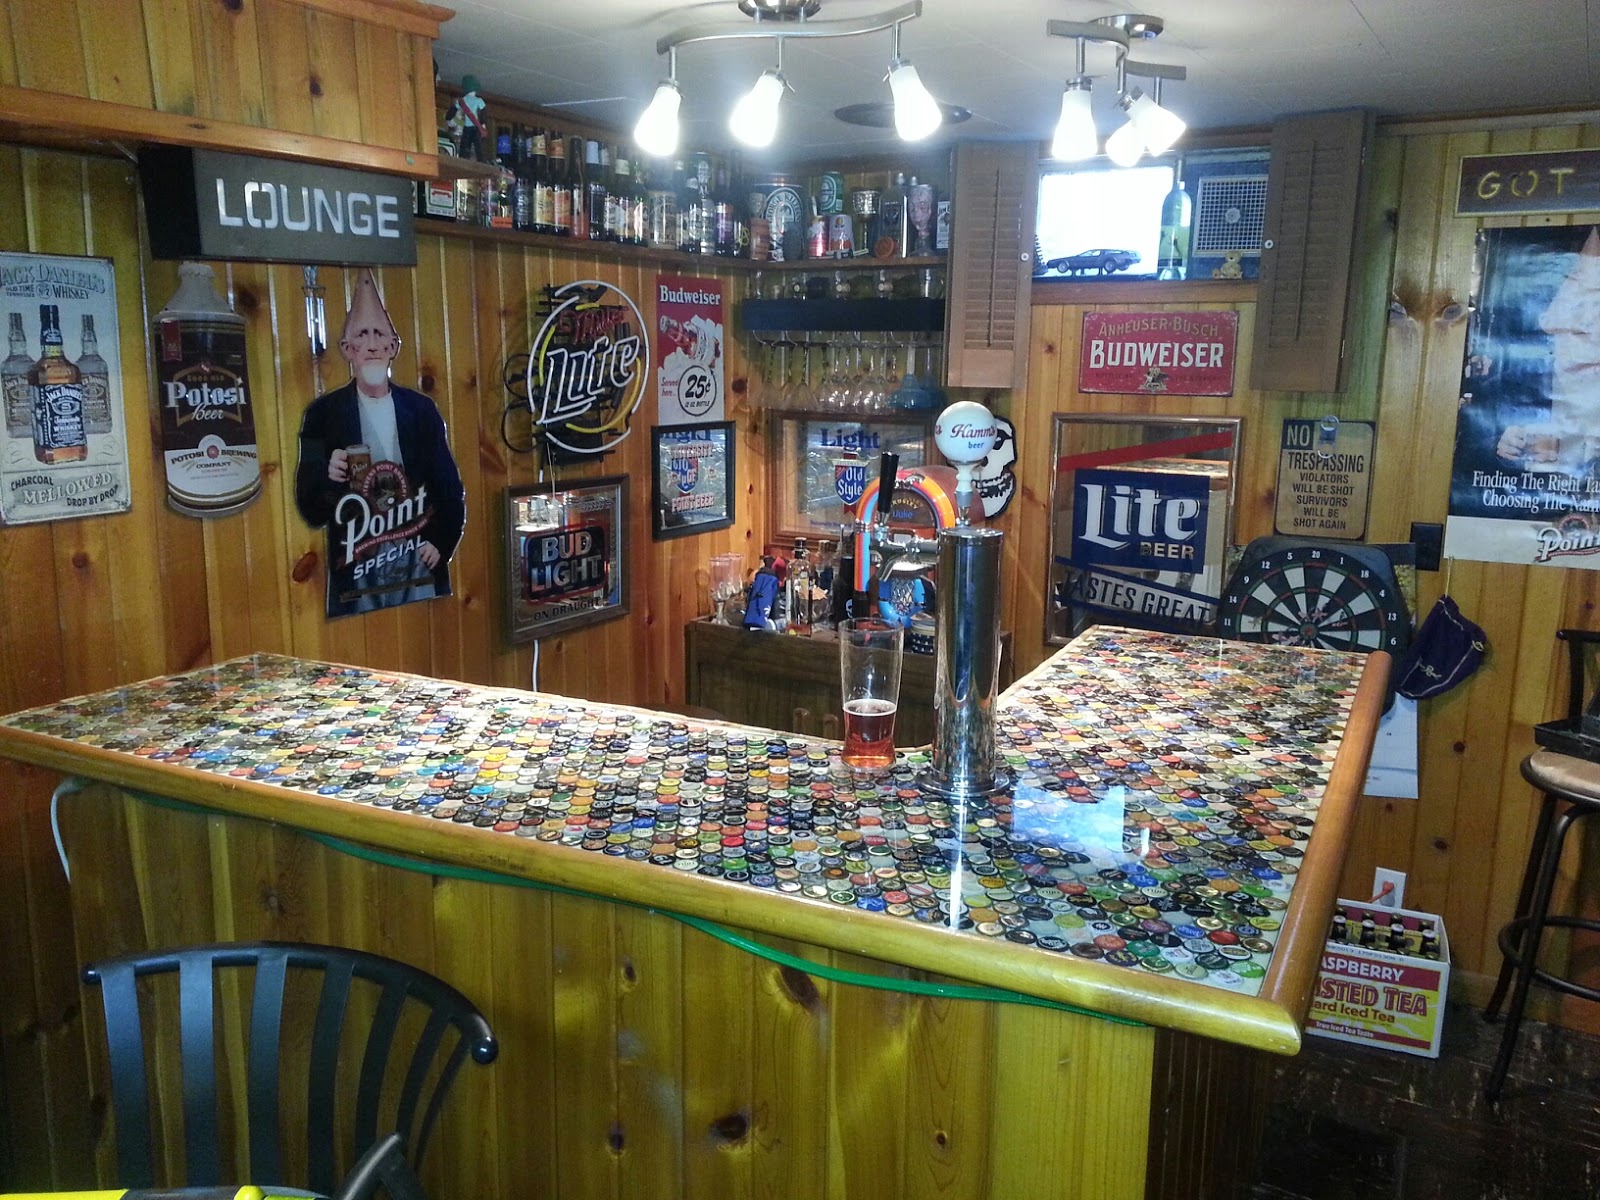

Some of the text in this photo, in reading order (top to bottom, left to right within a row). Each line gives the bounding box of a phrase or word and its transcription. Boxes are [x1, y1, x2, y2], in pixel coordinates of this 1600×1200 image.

[1478, 168, 1575, 199] GOT
[216, 178, 400, 238] LOUNGE
[20, 284, 35, 292] TIME
[52, 284, 90, 299] WHISKEY
[659, 285, 721, 306] Budweiser
[1089, 340, 1224, 369] BUDWEISER
[536, 336, 640, 425] Lite
[163, 377, 247, 408] Potosi
[191, 402, 224, 422] Beer
[820, 428, 881, 451] Light
[968, 441, 984, 449] beer
[1286, 424, 1310, 447] NO
[171, 449, 257, 464] POTOSI BREWING
[196, 461, 231, 469] COMPANY
[1288, 452, 1364, 473] TRESPASSING
[11, 476, 54, 491] CHARCOAL
[845, 467, 863, 481] Old
[1300, 472, 1349, 484] VIOLATORS
[1472, 470, 1518, 492] Finding
[1521, 472, 1545, 490] The
[1548, 475, 1580, 496] Right
[23, 472, 112, 505] MELLOWED
[67, 485, 119, 507] DROP BY DROP
[837, 479, 863, 501] Style
[1292, 483, 1355, 496] WILL BE SHOT
[1297, 495, 1348, 507] SURVIVORS
[1483, 489, 1539, 513] Choosing
[1543, 492, 1567, 511] The
[1078, 483, 1200, 550] Lite
[1303, 507, 1339, 518] WILL BE
[335, 484, 427, 564] Point
[1293, 518, 1346, 530] SHOT AGAIN
[542, 531, 592, 562] BUD
[1140, 541, 1194, 560] BEER
[1287, 552, 1293, 560] 5
[1312, 551, 1321, 559] 20
[353, 535, 426, 580] SPECIAL
[1261, 561, 1270, 569] 12
[1340, 557, 1344, 565] 1
[531, 555, 601, 592] LIGHT
[1244, 576, 1250, 584] 9
[1360, 570, 1369, 579] 18
[1063, 568, 1211, 627] TASTES GREAT
[1229, 595, 1237, 603] 14
[1379, 589, 1385, 598] 4
[534, 597, 601, 621] ON DRAUGHT
[1387, 612, 1397, 621] 13
[1224, 618, 1231, 627] 11
[1390, 637, 1396, 646] 6
[1321, 955, 1404, 982] ASPBERRY
[1314, 977, 1428, 1016] ISTED TEA
[1312, 1000, 1337, 1012] ard
[1340, 1004, 1369, 1018] Iced
[1371, 1009, 1395, 1023] Tea
[1316, 1021, 1375, 1038] True Iced Tea Taste
